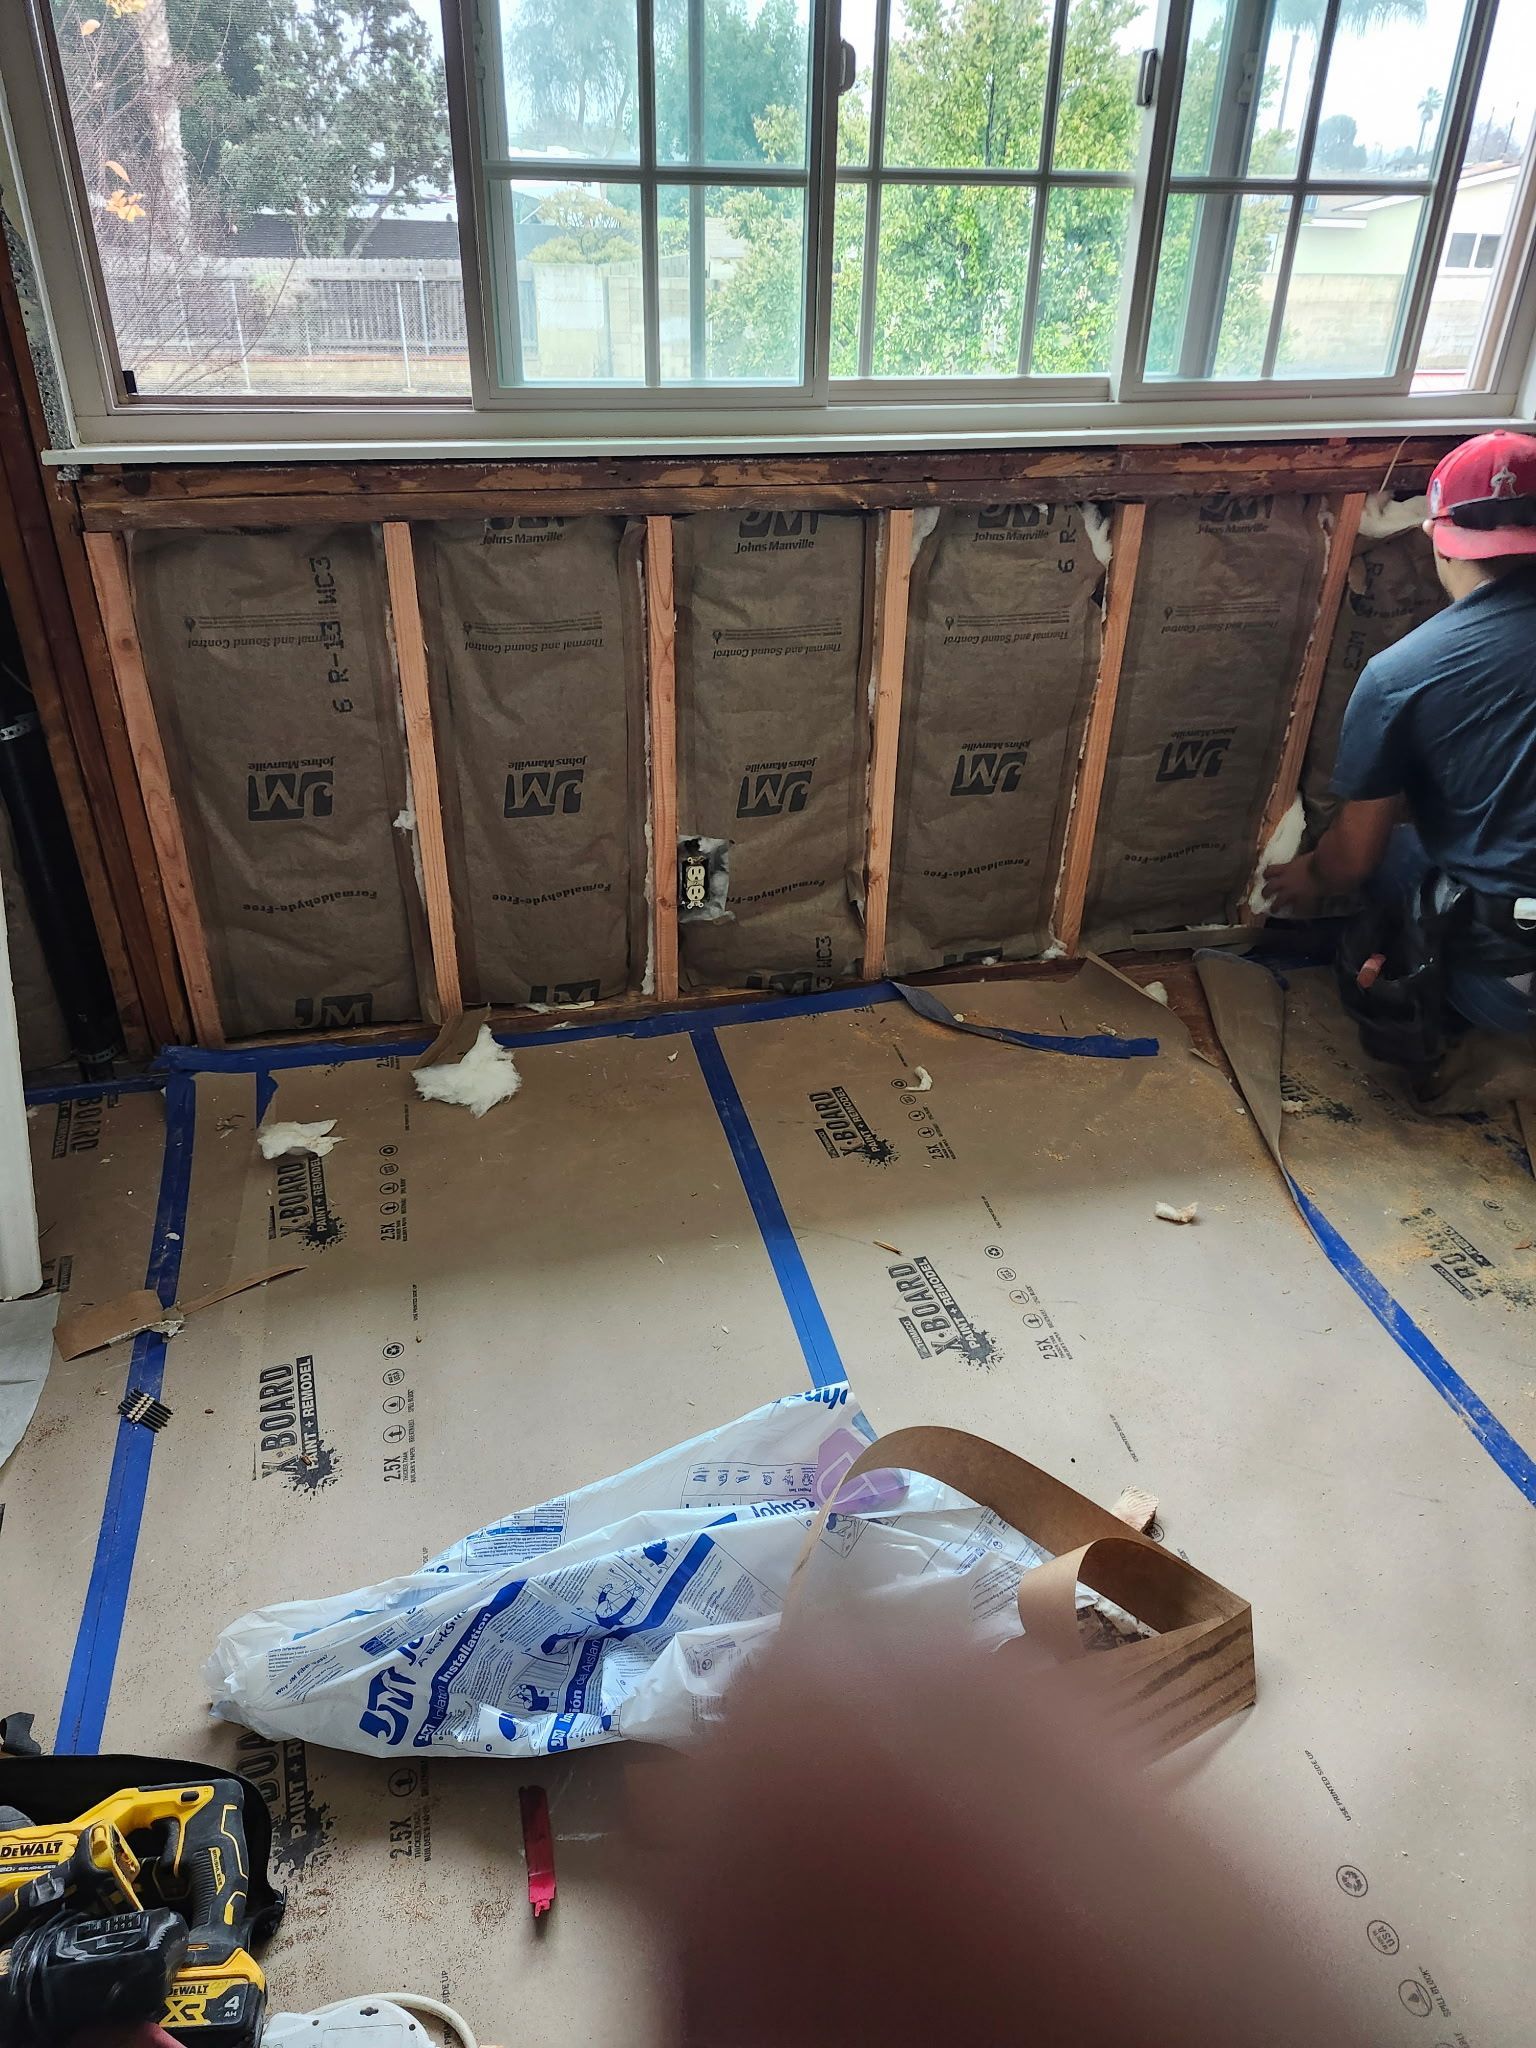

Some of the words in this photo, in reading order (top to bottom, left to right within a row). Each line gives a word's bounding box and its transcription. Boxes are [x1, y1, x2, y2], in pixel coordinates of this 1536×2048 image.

[480, 532, 513, 545] Johns
[515, 532, 563, 544] Manville
[973, 532, 1004, 542] Johns
[1006, 530, 1049, 541] Manville
[734, 542, 767, 554] Johns
[769, 539, 815, 551] Manville
[1058, 559, 1074, 573] 6
[188, 638, 230, 649] Control
[233, 637, 271, 648] Sound
[274, 635, 295, 647] and
[563, 638, 604, 650] Thermal
[944, 635, 979, 645] Control
[981, 634, 1012, 644] Sound
[1014, 633, 1031, 643] and
[1032, 631, 1068, 642] Thermal
[465, 641, 500, 654] Control
[505, 641, 538, 654] Sound
[540, 640, 560, 652] and
[713, 648, 750, 660] Control
[752, 647, 782, 657] Sound
[785, 645, 801, 656] and
[805, 643, 841, 654] Thermal
[332, 699, 353, 712] 6
[248, 760, 300, 771] Manville
[301, 756, 337, 768] Johns
[508, 758, 554, 770] Manville
[555, 755, 587, 767] Johns
[745, 761, 788, 772] Manville
[789, 757, 818, 767] Johns
[1156, 738, 1231, 782] JM
[950, 752, 1027, 796] JM
[248, 770, 333, 822] JM
[504, 769, 583, 818] JM
[736, 770, 812, 818] JM
[242, 890, 377, 914] Formaldehyde-Free
[492, 883, 612, 905] Formaldehyde-Free
[836, 1089, 861, 1122] REMODEL
[864, 1133, 881, 1153] PAINT
[310, 1158, 323, 1196] REMODEL
[316, 1205, 328, 1232] PAINT
[380, 1222, 396, 1241] 2.5X
[918, 1258, 953, 1306] REMODEL
[904, 1321, 926, 1349] TRIMACO
[953, 1317, 981, 1349] PAINT
[1034, 1338, 1059, 1360] 2.5X
[299, 1358, 315, 1418] REMODEL
[383, 1456, 401, 1482] 2.5X
[438, 1612, 492, 1682] Installation
[359, 1666, 416, 1746] JM
[1311, 1758, 1325, 1776] SIDE
[1321, 1775, 1343, 1806] PRINTED
[287, 1780, 307, 1839] PAINT
[1337, 1806, 1352, 1822] USE
[389, 1816, 413, 1860] 2.5X
[1, 1839, 62, 1858] DEWALT
[1377, 1926, 1396, 1948] USA
[224, 1995, 241, 2011] 4
[165, 1999, 209, 2026] XR
[224, 2010, 237, 2018] AH
